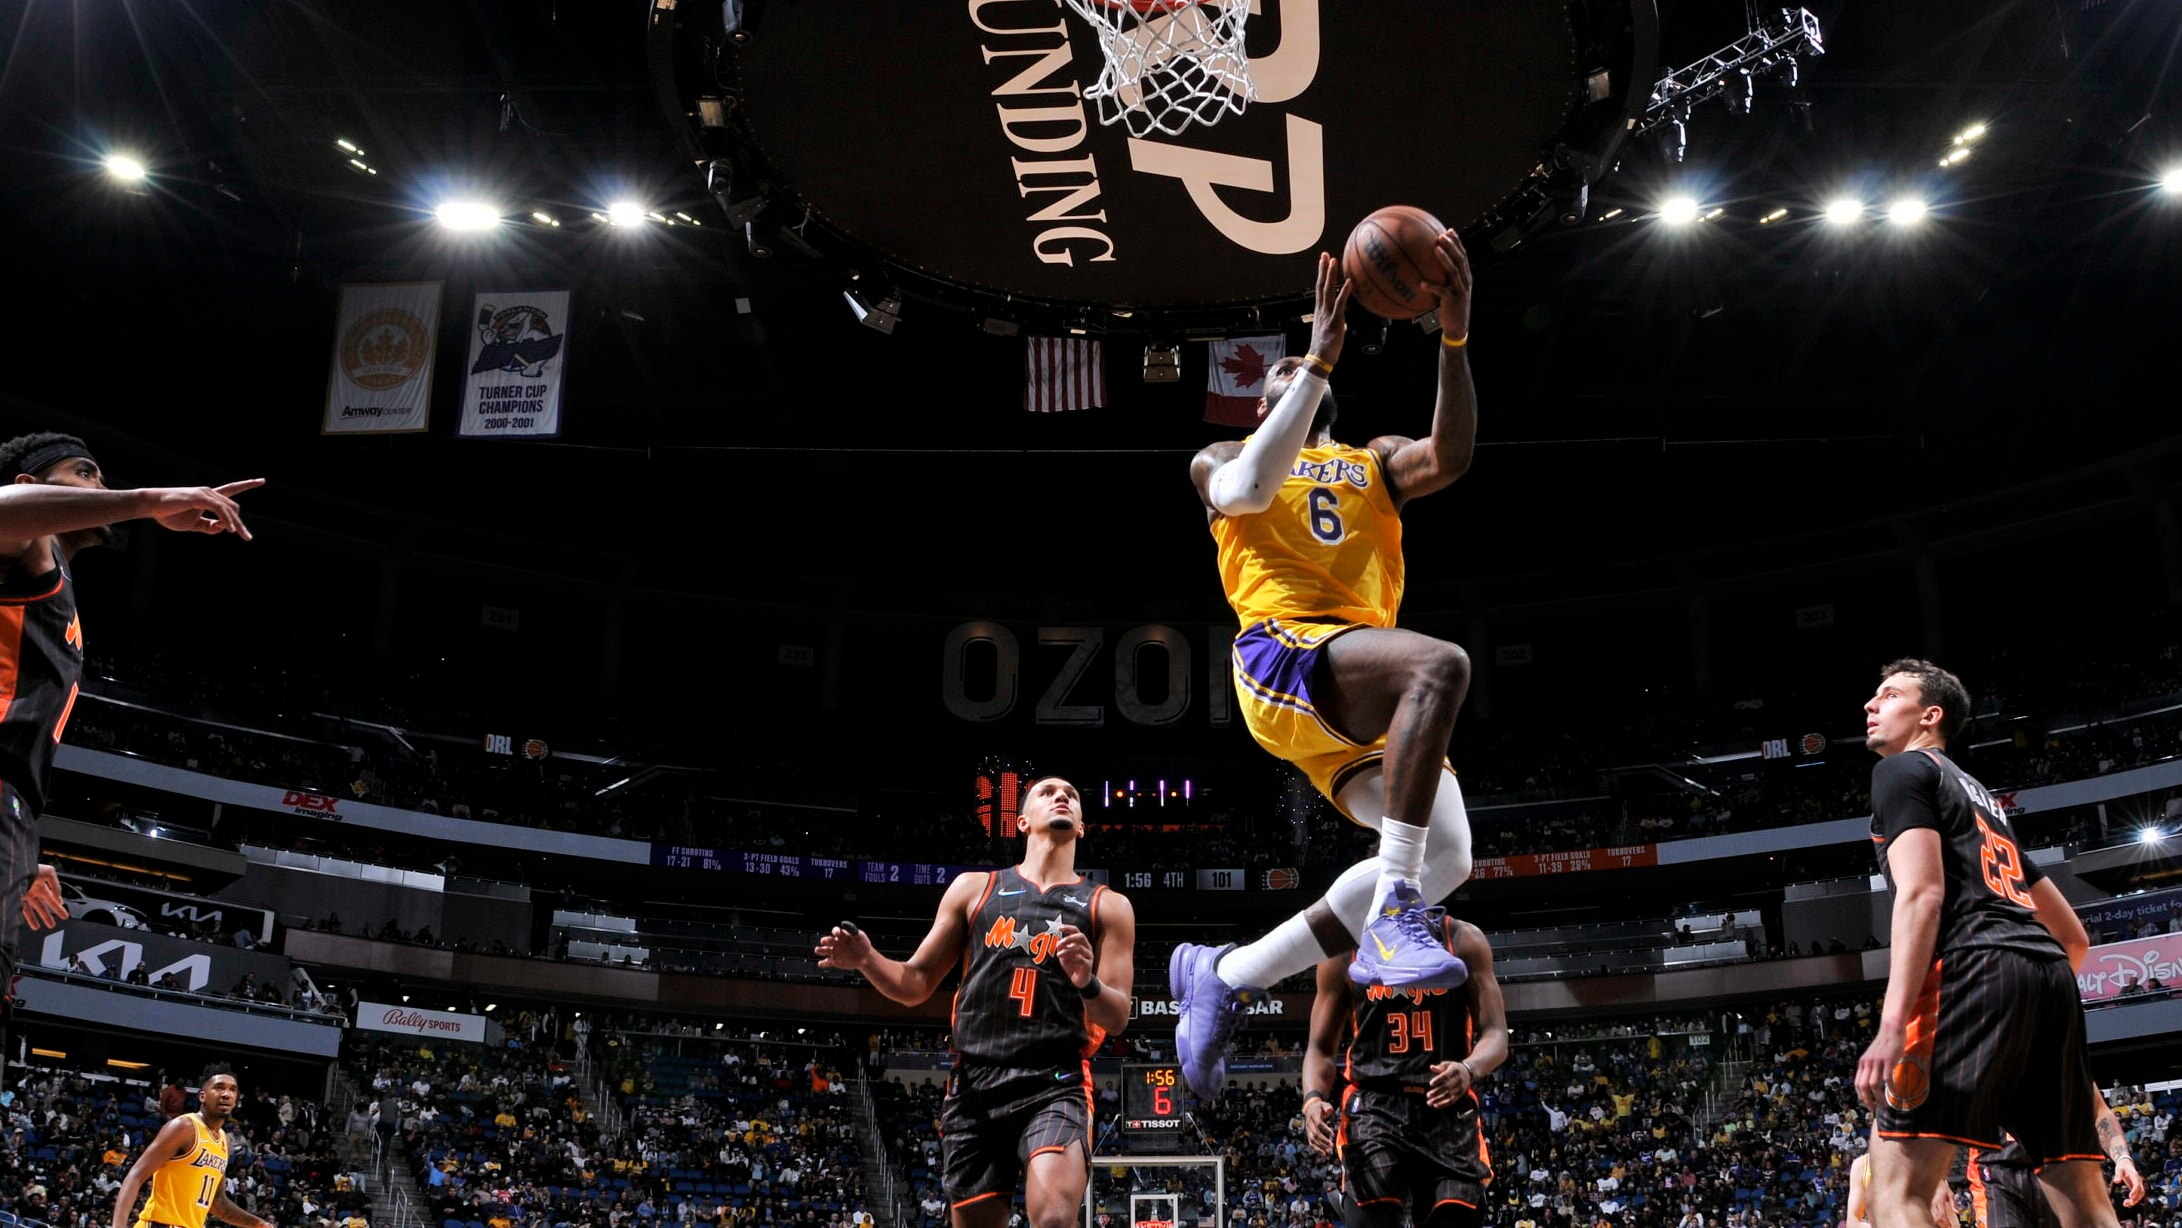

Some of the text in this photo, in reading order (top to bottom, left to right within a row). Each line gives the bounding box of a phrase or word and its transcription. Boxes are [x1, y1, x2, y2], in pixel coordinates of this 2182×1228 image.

[968, 0, 1117, 267] UNDING
[479, 384, 547, 400] TURNER CUP
[341, 405, 383, 420] Amway
[479, 400, 543, 414] CHAMPIONS
[484, 417, 534, 429] 2000-2001
[1291, 458, 1369, 489] KERS
[1308, 486, 1345, 545] 6
[942, 620, 1237, 725] OZO
[281, 790, 341, 813] DEX
[760, 853, 778, 863] FIELD
[1607, 846, 1646, 857] TURNOVERS
[667, 855, 721, 871] 17-21 81%
[745, 861, 800, 877] 13-30 43%
[811, 857, 848, 869] TURNOVERS
[867, 862, 885, 873] TEAM
[915, 864, 931, 874] TIME
[1538, 861, 1563, 874] 11-39
[1622, 856, 1631, 867] 17
[1975, 811, 2038, 911] 22
[824, 868, 834, 879] 17
[865, 872, 886, 883] FOULS
[889, 865, 899, 882] 2
[914, 874, 931, 885] OUTS
[936, 867, 946, 884] 2
[1212, 871, 1232, 889] 101
[1493, 866, 1513, 878] 77%
[1124, 872, 1184, 889] 1:56 4TH
[2104, 909, 2134, 920] 2-day
[2136, 902, 2167, 916] ticket
[2170, 899, 2182, 909] fo
[2077, 971, 2107, 994] ALT
[1009, 967, 1037, 1018] 4
[383, 1009, 461, 1032] Bally SPORTS
[1387, 1010, 1434, 1054] 34
[1146, 1069, 1175, 1086] 1:56
[1153, 1086, 1172, 1116] 6
[1141, 1119, 1181, 1129] TISSOT
[197, 1174, 215, 1207] 11
